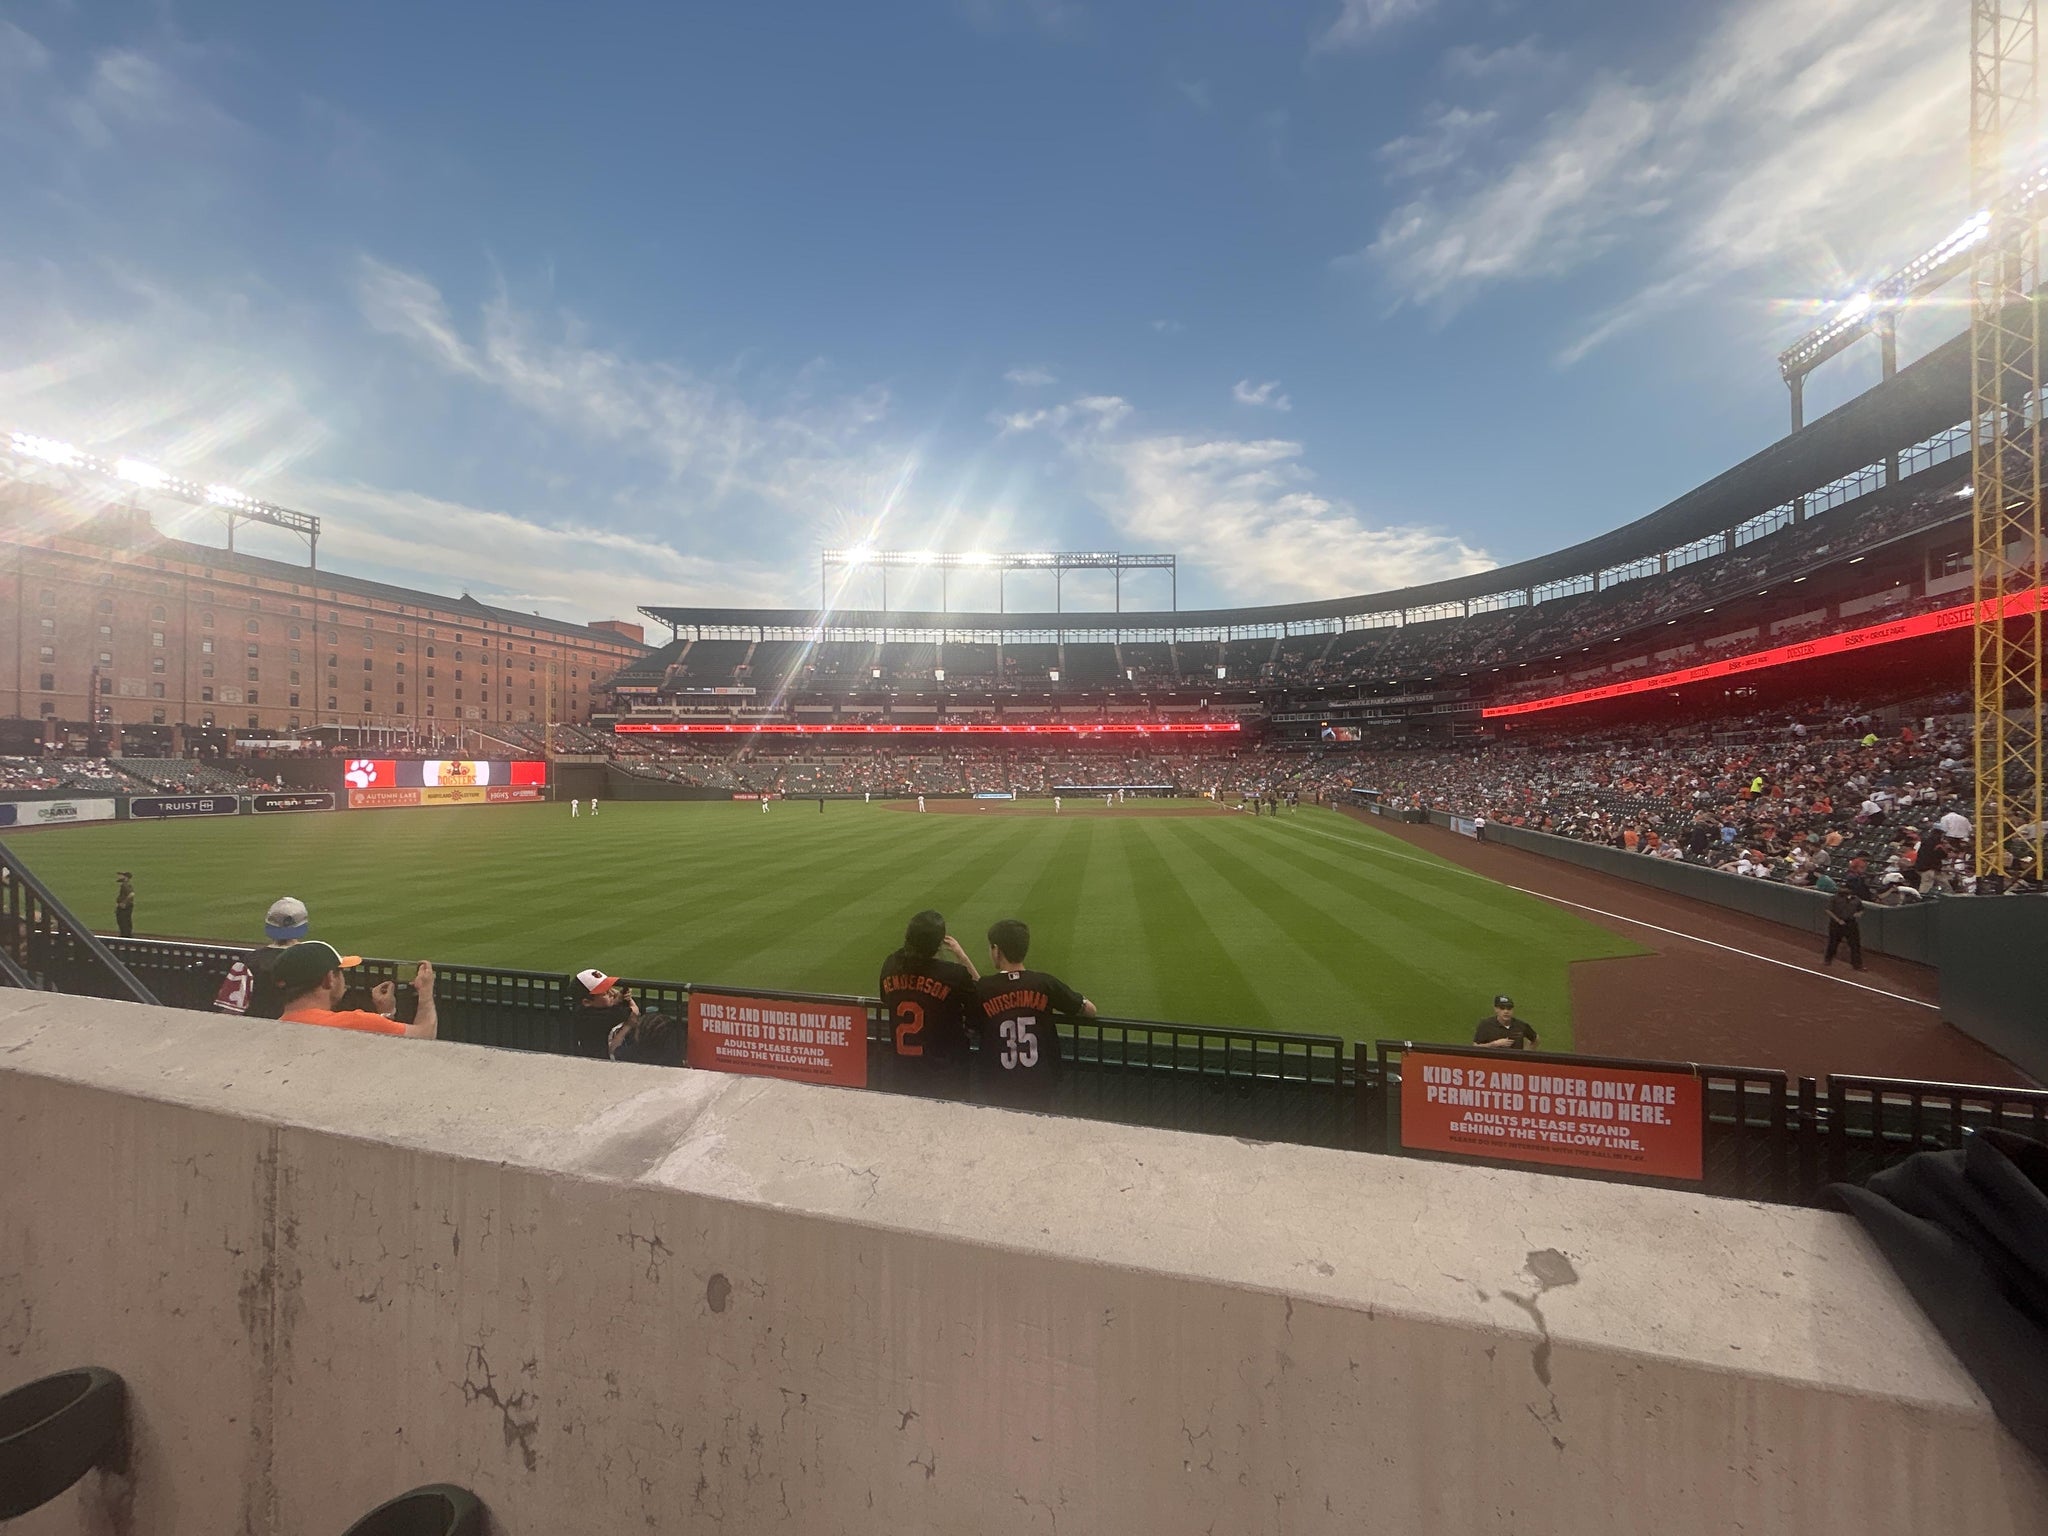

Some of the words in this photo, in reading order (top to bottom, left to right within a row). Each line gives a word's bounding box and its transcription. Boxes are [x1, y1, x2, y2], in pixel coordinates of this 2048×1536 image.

[158, 802, 198, 810] TRUIST
[883, 975, 952, 1000] HENDERSON
[700, 1003, 724, 1018] KIDS
[726, 1006, 736, 1020] 12
[738, 1008, 759, 1022] AND
[762, 1010, 797, 1026] UNDER
[800, 1012, 827, 1028] ONLY
[829, 1015, 852, 1030] ARE
[982, 990, 1049, 1018] RUTSCHMAN
[702, 1018, 760, 1038] PERMITTED
[762, 1026, 776, 1040] TO
[778, 1027, 813, 1044] STAND
[816, 1030, 849, 1047] HERE.
[896, 1001, 924, 1056] 2
[716, 1046, 748, 1058] BEHIND
[751, 1050, 768, 1060] THE
[770, 1053, 807, 1064] YELLOW
[808, 1058, 832, 1067] LINE.
[724, 1038, 756, 1049] ADULTS
[758, 1042, 791, 1054] PLEASE
[793, 1046, 824, 1056] STAND
[1000, 1016, 1038, 1070] 35
[1424, 1065, 1463, 1086] KIDS
[1467, 1070, 1485, 1088] 12
[1490, 1072, 1524, 1091] AND
[1528, 1074, 1587, 1098] UNDER
[1592, 1080, 1636, 1101] ONLY
[1640, 1084, 1676, 1104] ARE
[1427, 1086, 1524, 1112] PERMITTED
[1528, 1096, 1550, 1114] TO
[1555, 1098, 1614, 1120] STAND
[1618, 1102, 1672, 1126] HERE.
[1450, 1122, 1506, 1136] BEHIND
[1508, 1127, 1536, 1140] THE
[1540, 1130, 1602, 1148] YELLOW
[1604, 1137, 1645, 1152] LINE.
[1464, 1112, 1518, 1127] ADULTS
[1521, 1117, 1576, 1132] PLEASE
[1579, 1122, 1630, 1137] STAND
